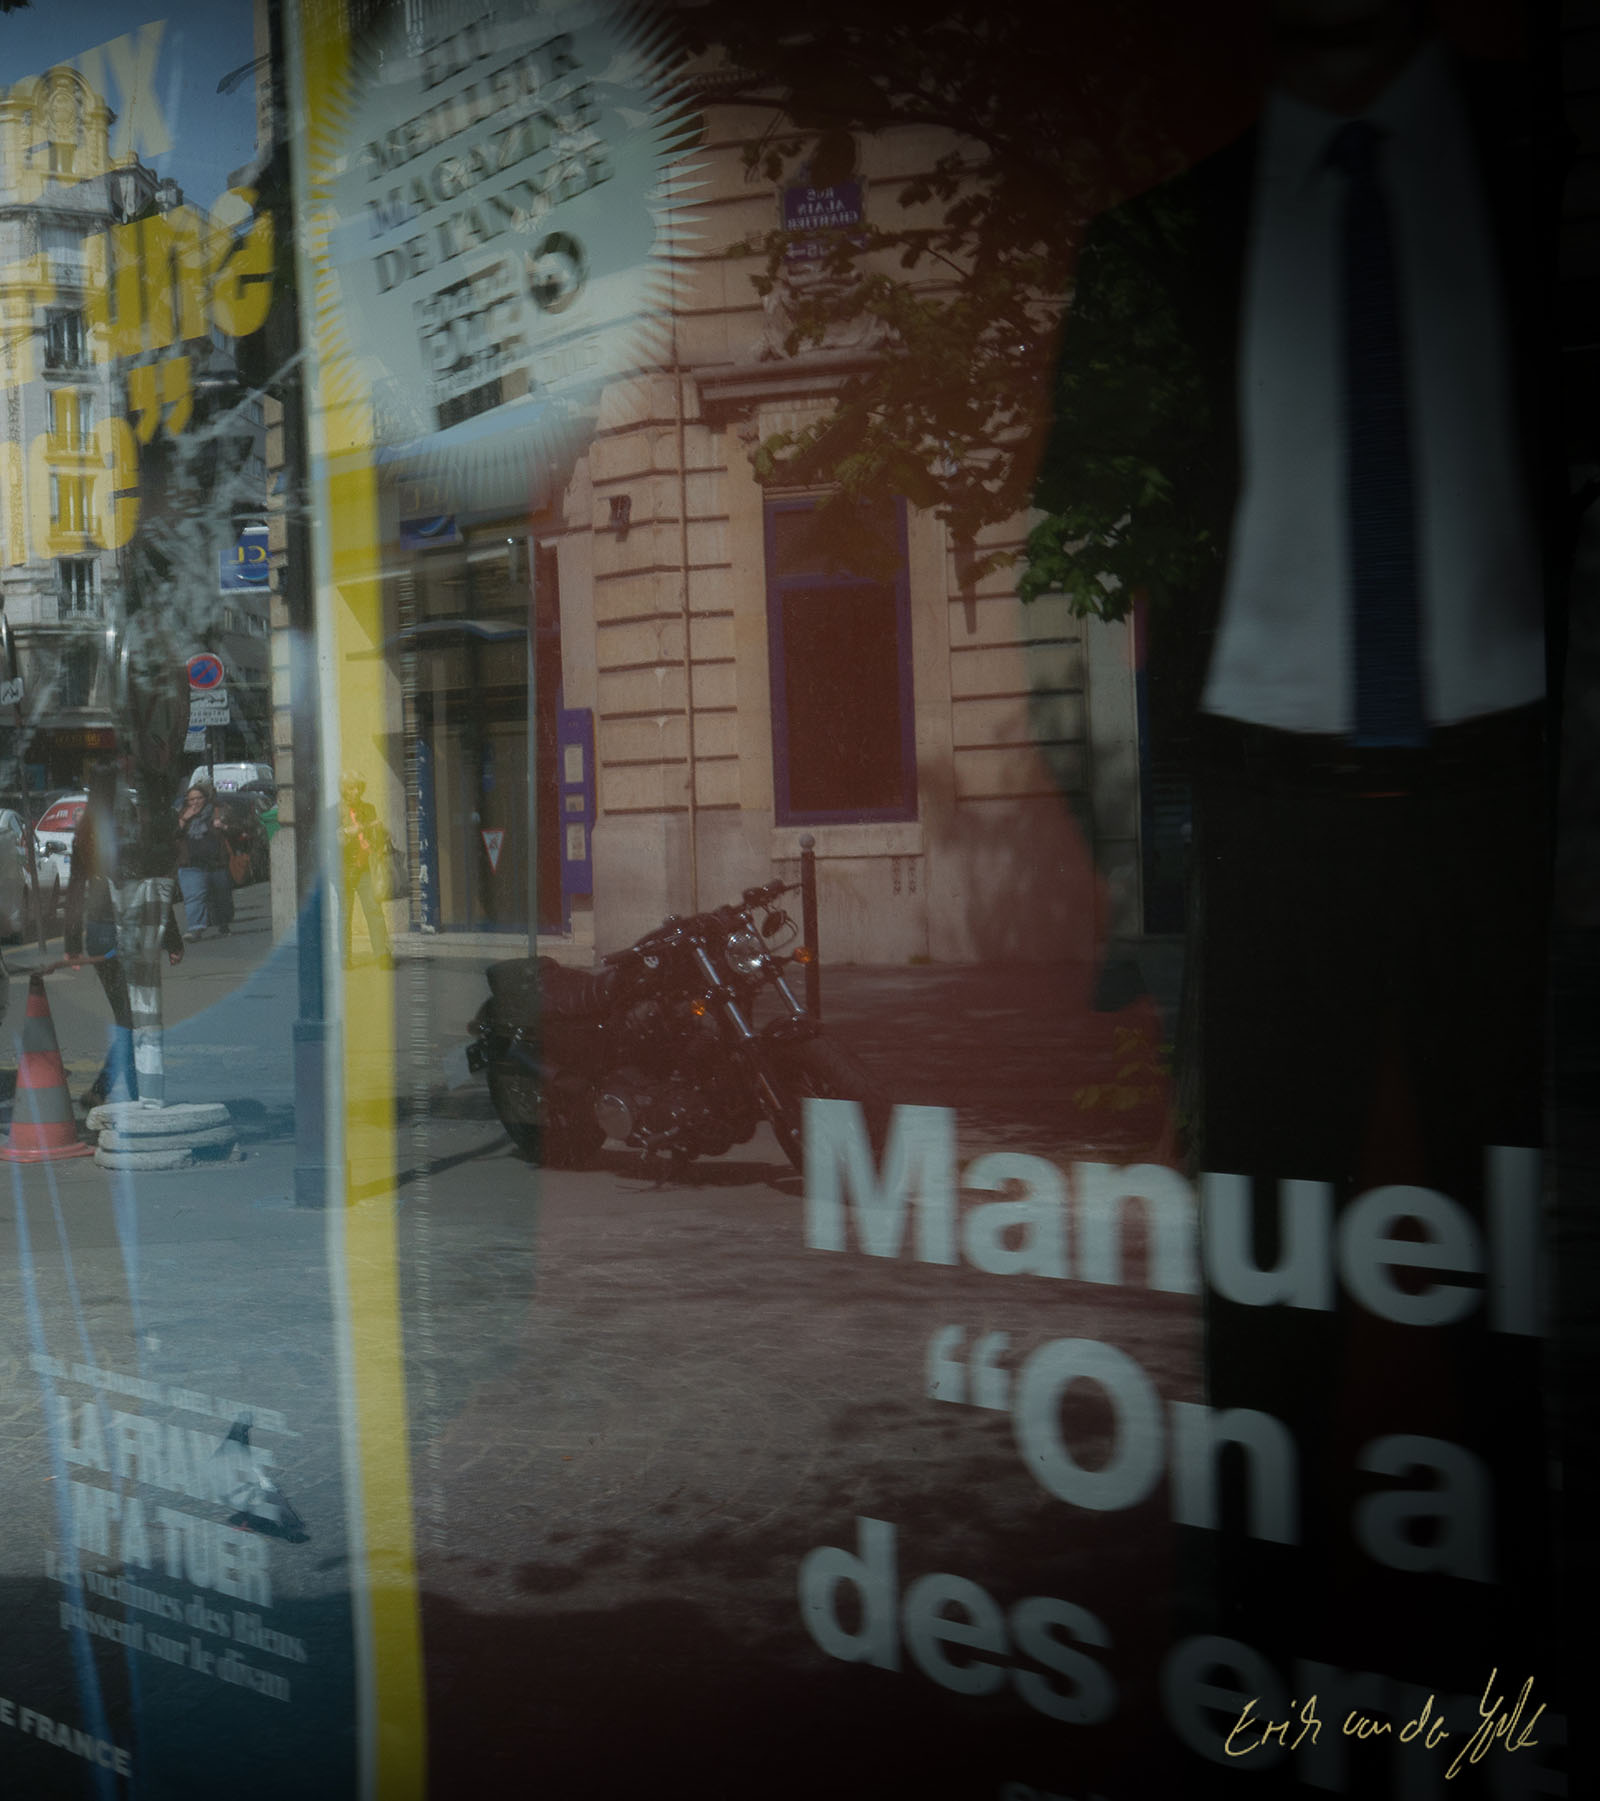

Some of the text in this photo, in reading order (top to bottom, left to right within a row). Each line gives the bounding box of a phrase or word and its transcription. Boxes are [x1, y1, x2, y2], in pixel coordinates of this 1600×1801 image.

[800, 1096, 1548, 1339] Manuel
[156, 1507, 273, 1608] TUER
[1349, 1432, 1499, 1585] a
[799, 1515, 1119, 1725] des
[18, 1705, 133, 1779] FRANCE
